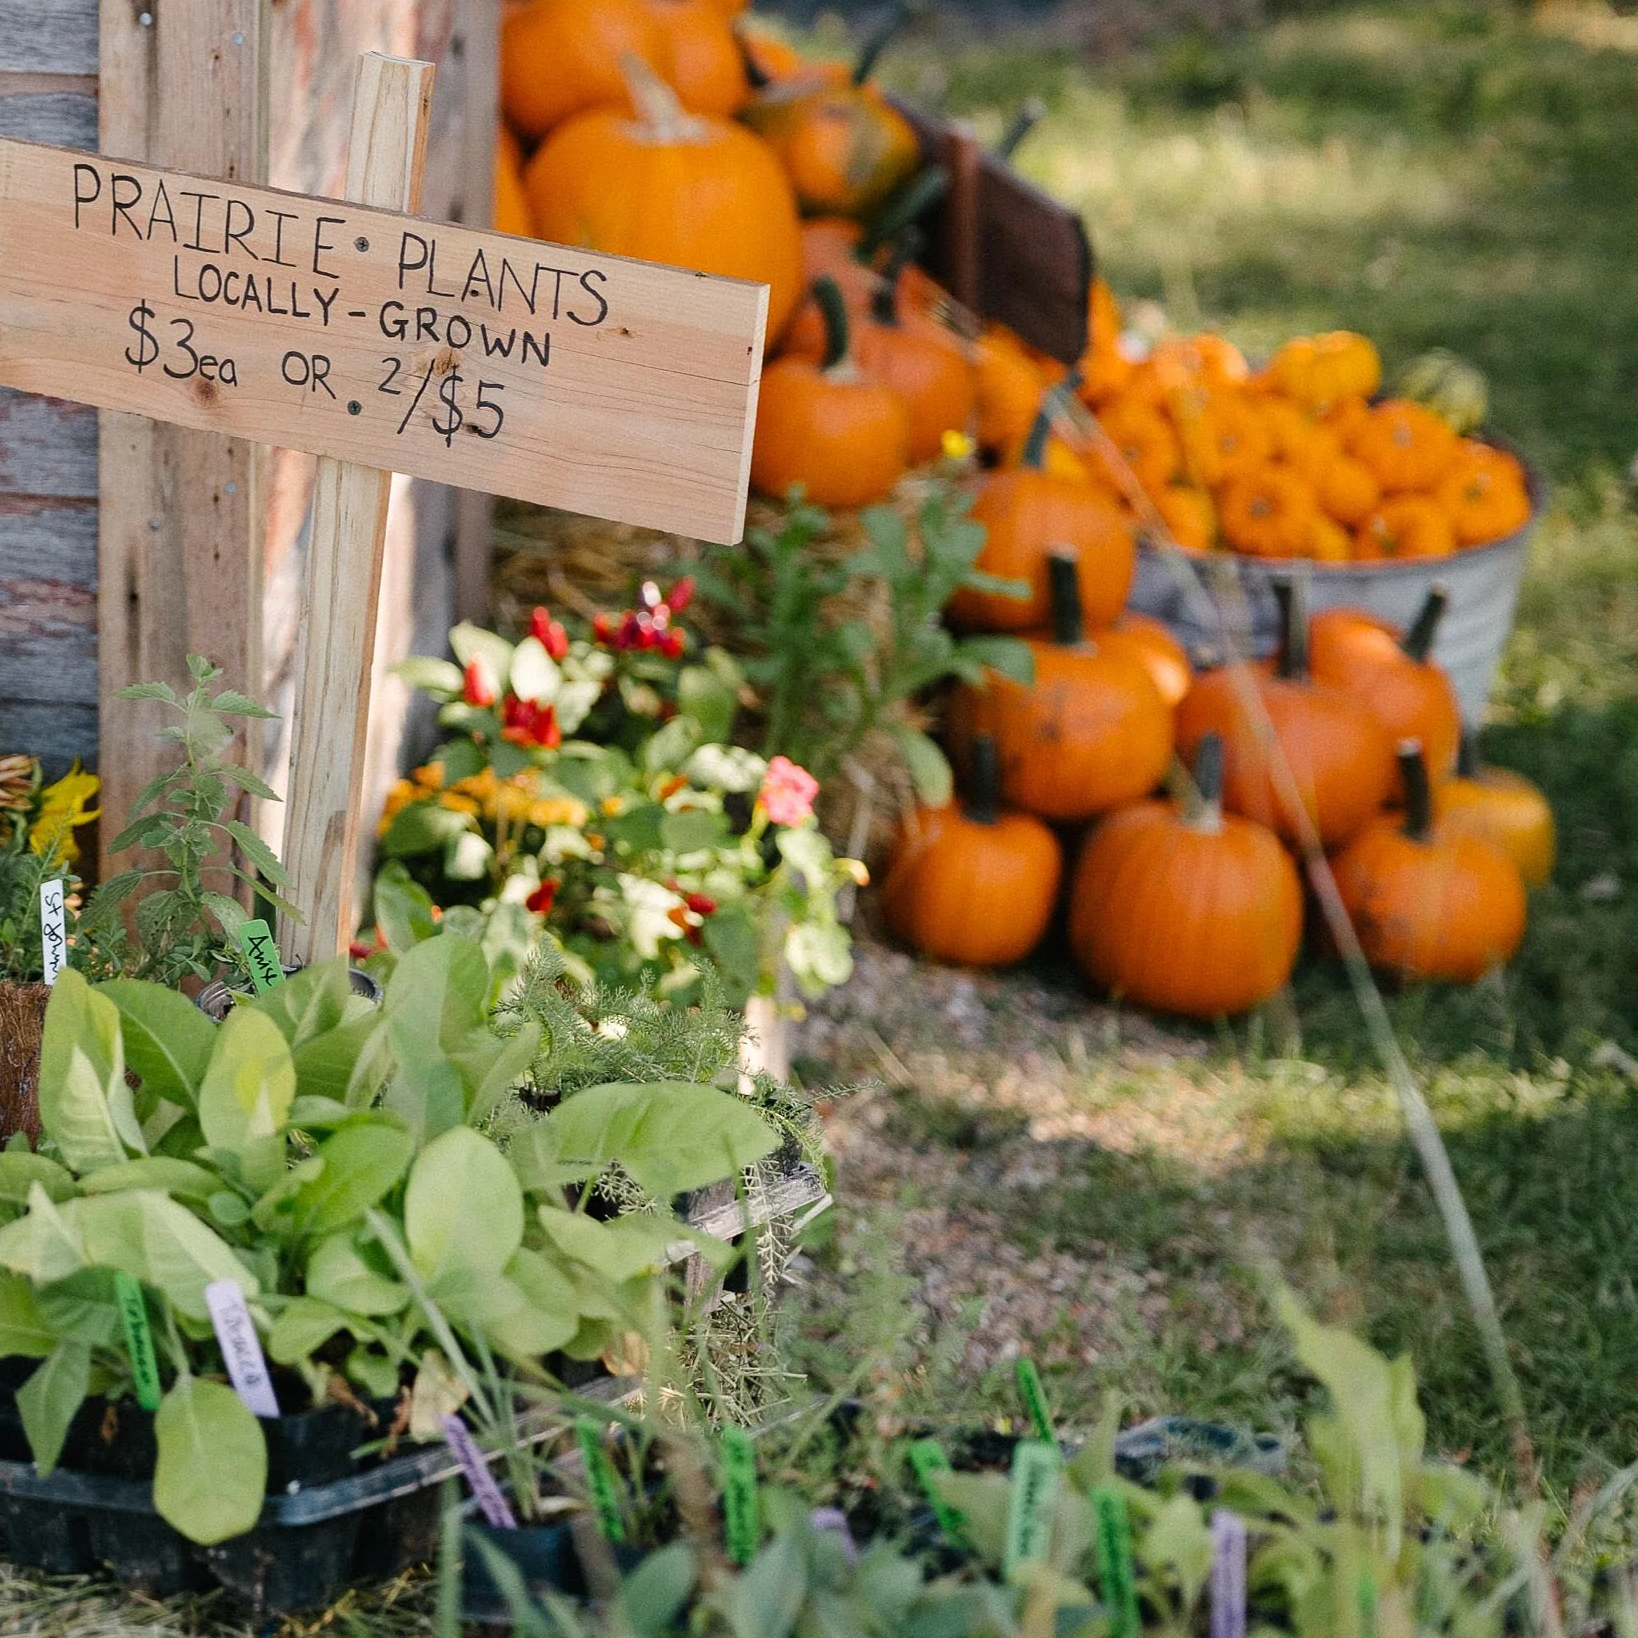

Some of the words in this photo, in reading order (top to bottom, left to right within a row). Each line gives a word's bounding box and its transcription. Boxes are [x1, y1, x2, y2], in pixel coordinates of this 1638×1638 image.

[73, 162, 347, 280] PRAIRIE
[398, 231, 609, 327] PLANTS
[124, 298, 238, 388] $3ea
[281, 350, 337, 400] OR
[377, 356, 506, 449] 2/$5
